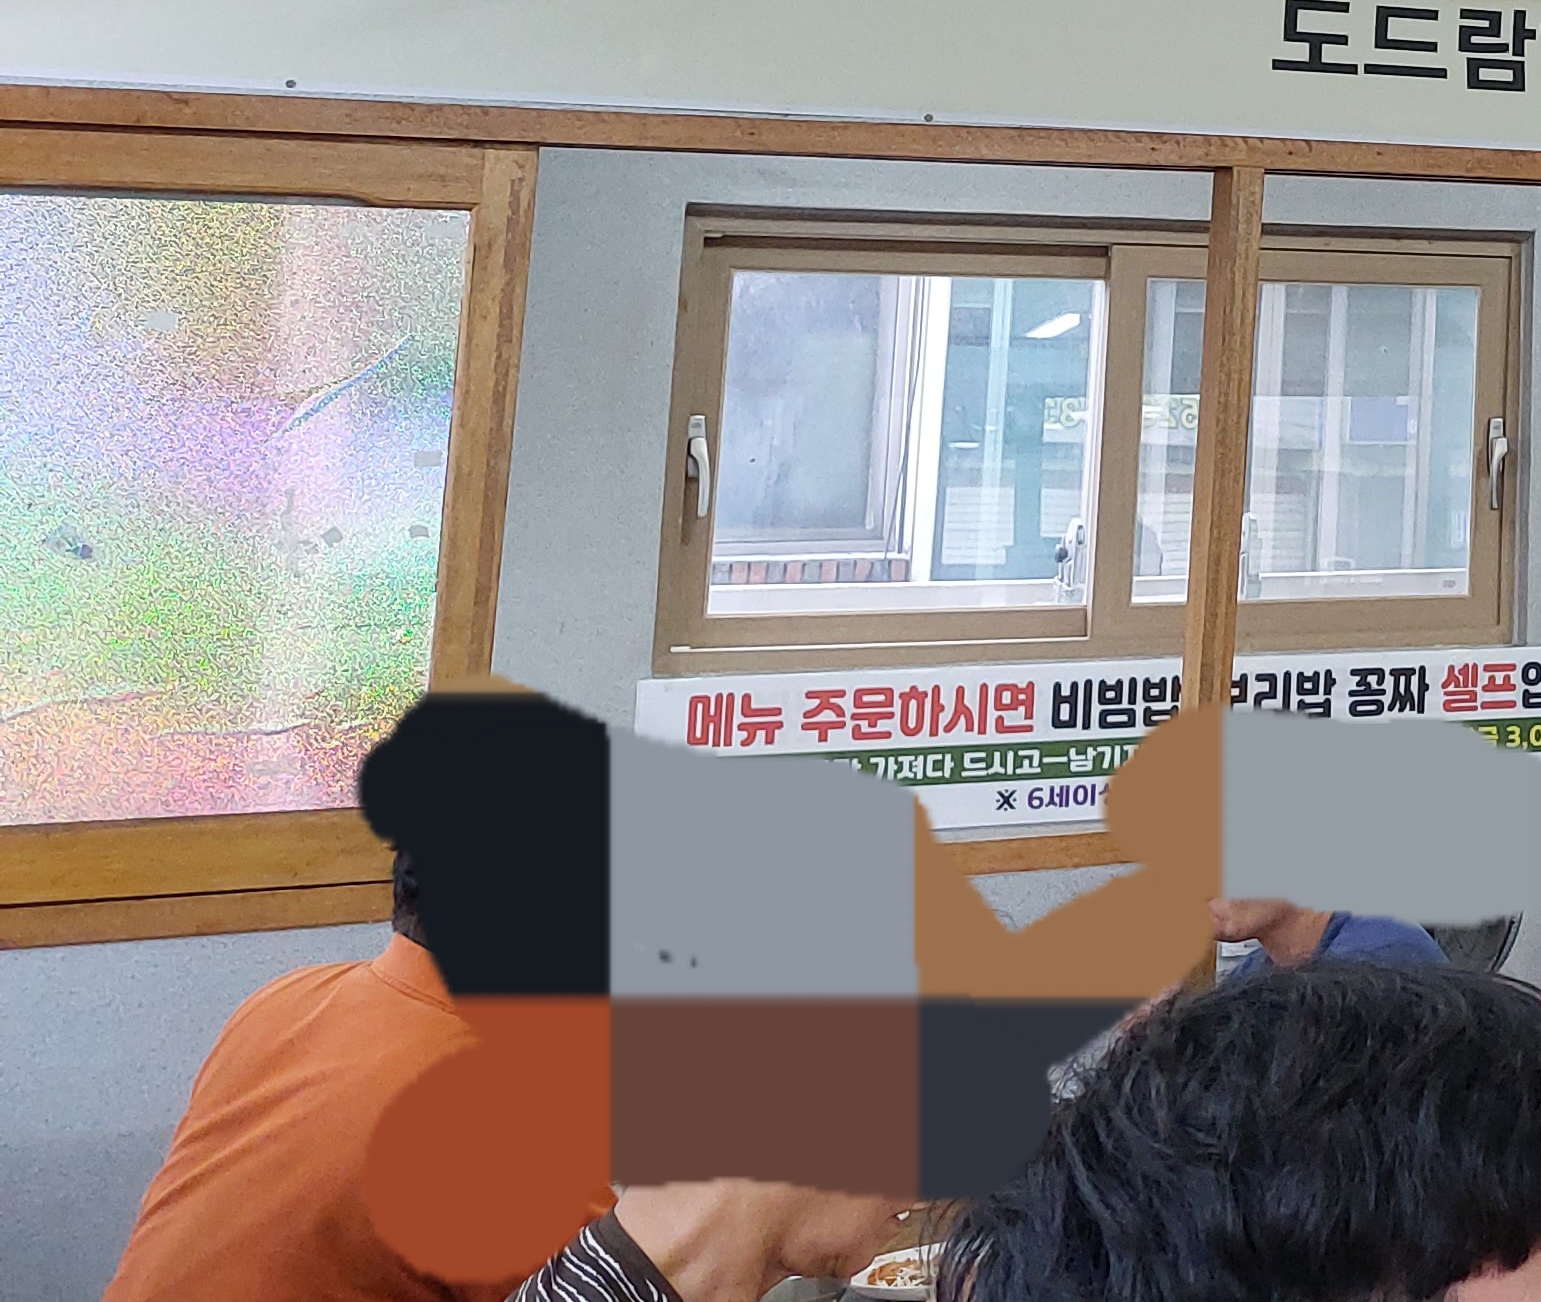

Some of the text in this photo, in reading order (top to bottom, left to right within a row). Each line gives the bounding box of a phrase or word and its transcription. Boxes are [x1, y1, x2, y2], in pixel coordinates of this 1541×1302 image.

[686, 692, 784, 747] 메뉴
[801, 681, 1036, 742] 주문하시면
[1051, 674, 1181, 730] 비빔밥
[1348, 665, 1429, 717] 꽁짜
[870, 754, 953, 780] 가져다
